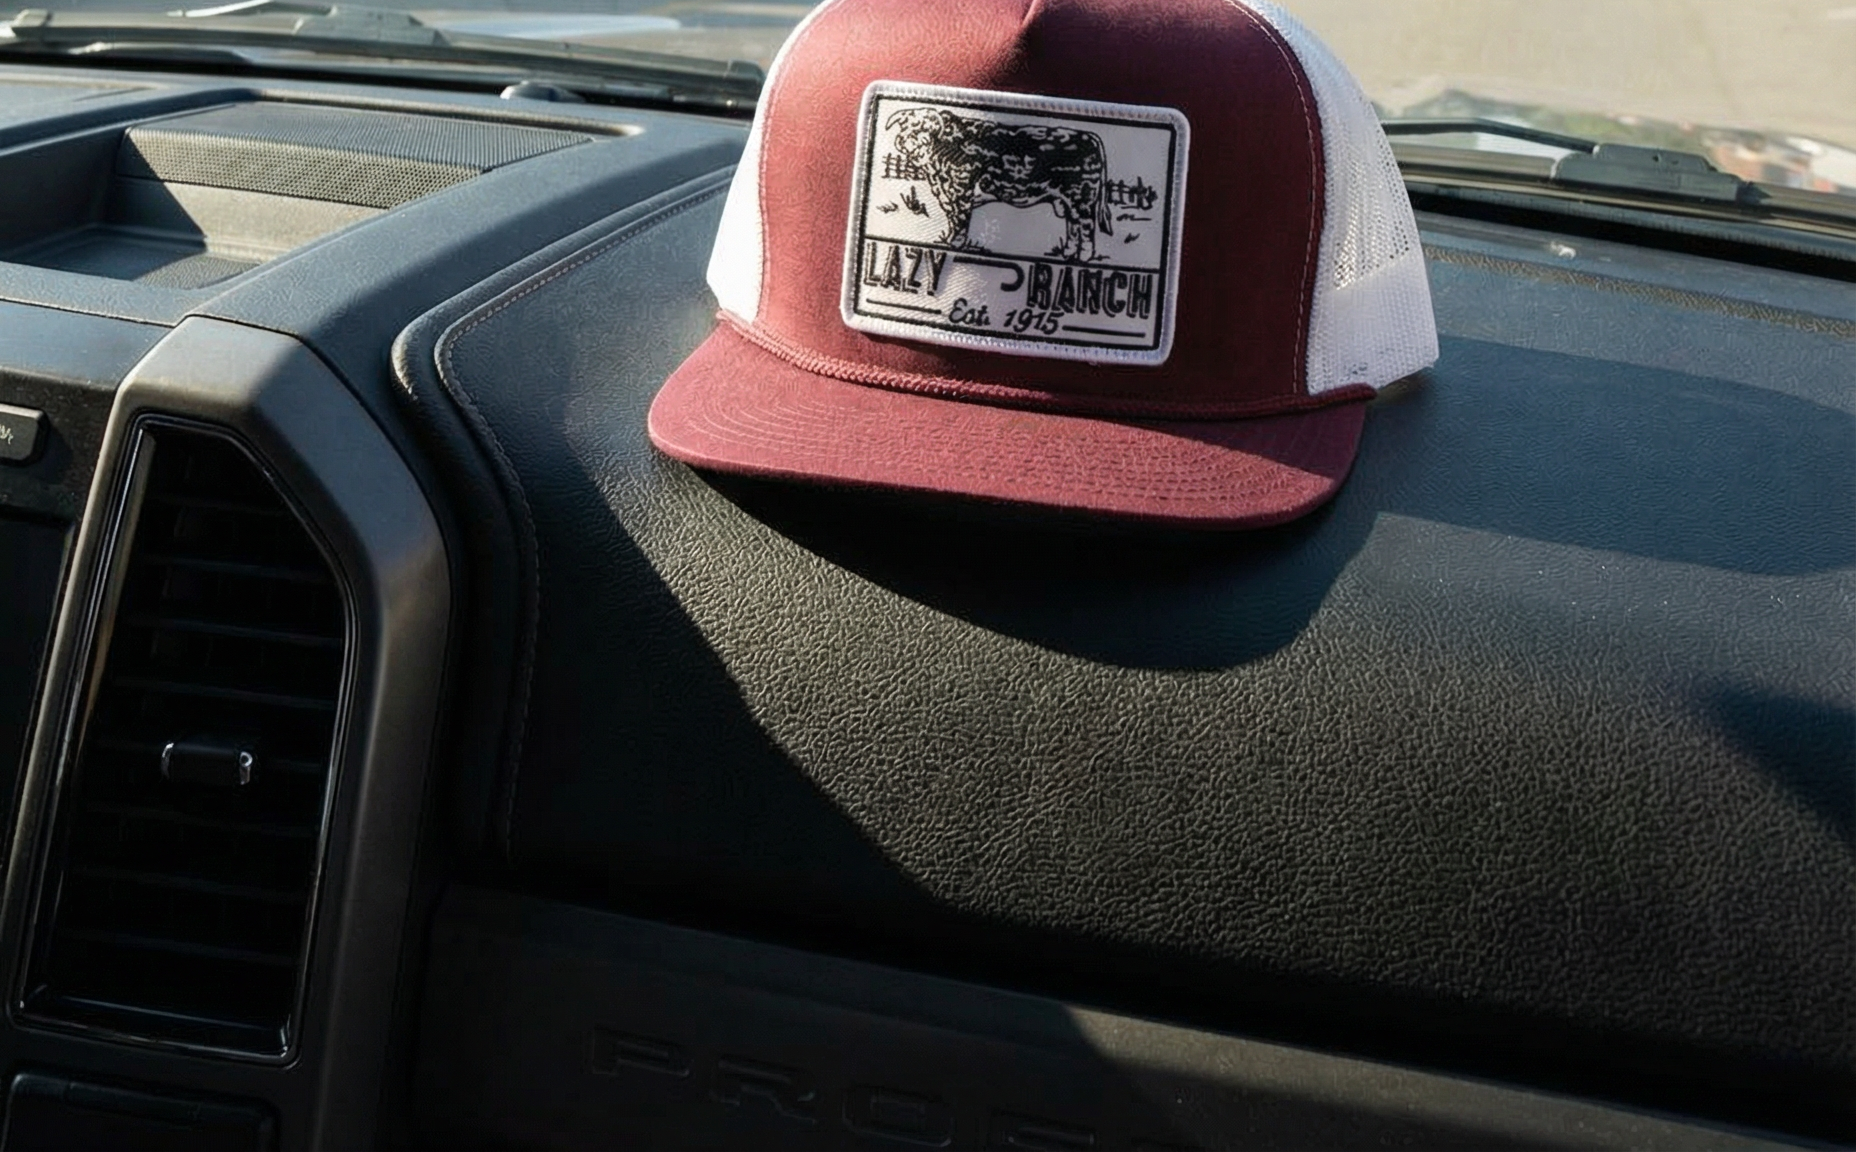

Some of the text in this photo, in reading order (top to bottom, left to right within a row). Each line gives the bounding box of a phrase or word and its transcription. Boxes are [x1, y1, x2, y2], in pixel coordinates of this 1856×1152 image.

[863, 241, 946, 295] LAZY
[1026, 261, 1154, 320] RANCH
[1004, 306, 1065, 336] 1915
